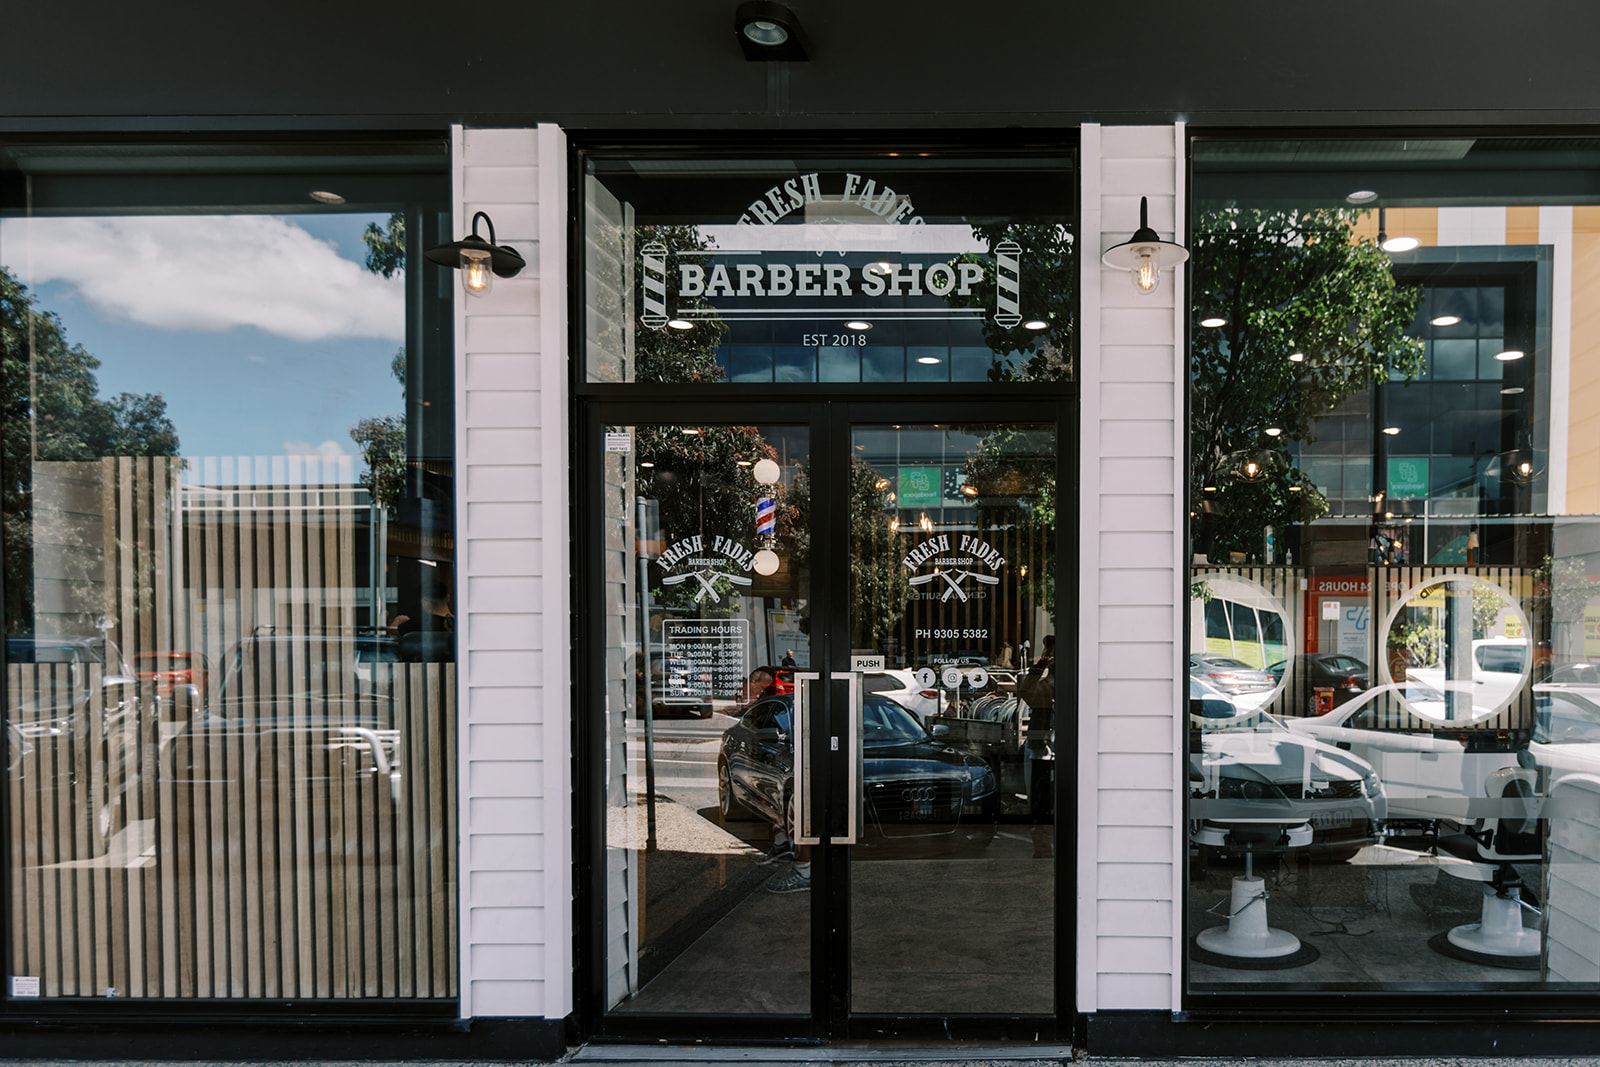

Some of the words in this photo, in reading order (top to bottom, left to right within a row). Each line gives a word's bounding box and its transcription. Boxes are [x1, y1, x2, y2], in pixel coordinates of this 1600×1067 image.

[678, 263, 852, 297] BARBER
[861, 262, 984, 297] SHOP
[803, 334, 827, 347] EST
[832, 334, 866, 347] 2018
[655, 534, 704, 572] FRESH
[713, 534, 759, 572] FADES
[902, 534, 950, 572] FRESH
[959, 534, 1006, 571] FADES
[669, 626, 709, 634] TRADING
[711, 626, 743, 634] HOURS
[915, 629, 931, 639] PH
[934, 629, 960, 639] 9305
[962, 629, 988, 639] 5382
